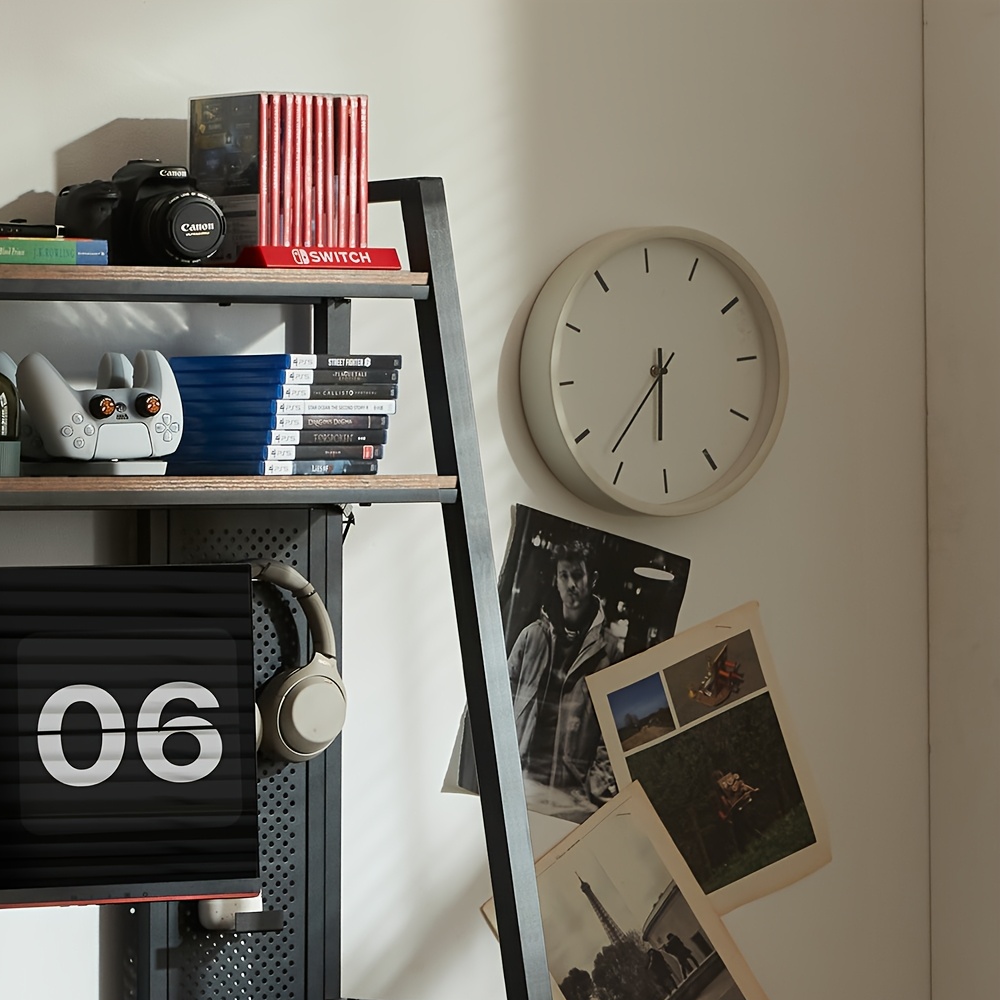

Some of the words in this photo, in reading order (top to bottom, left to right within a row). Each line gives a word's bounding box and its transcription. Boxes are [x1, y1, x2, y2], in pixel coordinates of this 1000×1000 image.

[181, 223, 214, 232] Canon
[309, 251, 371, 263] SWITCH
[36, 681, 224, 787] 06
